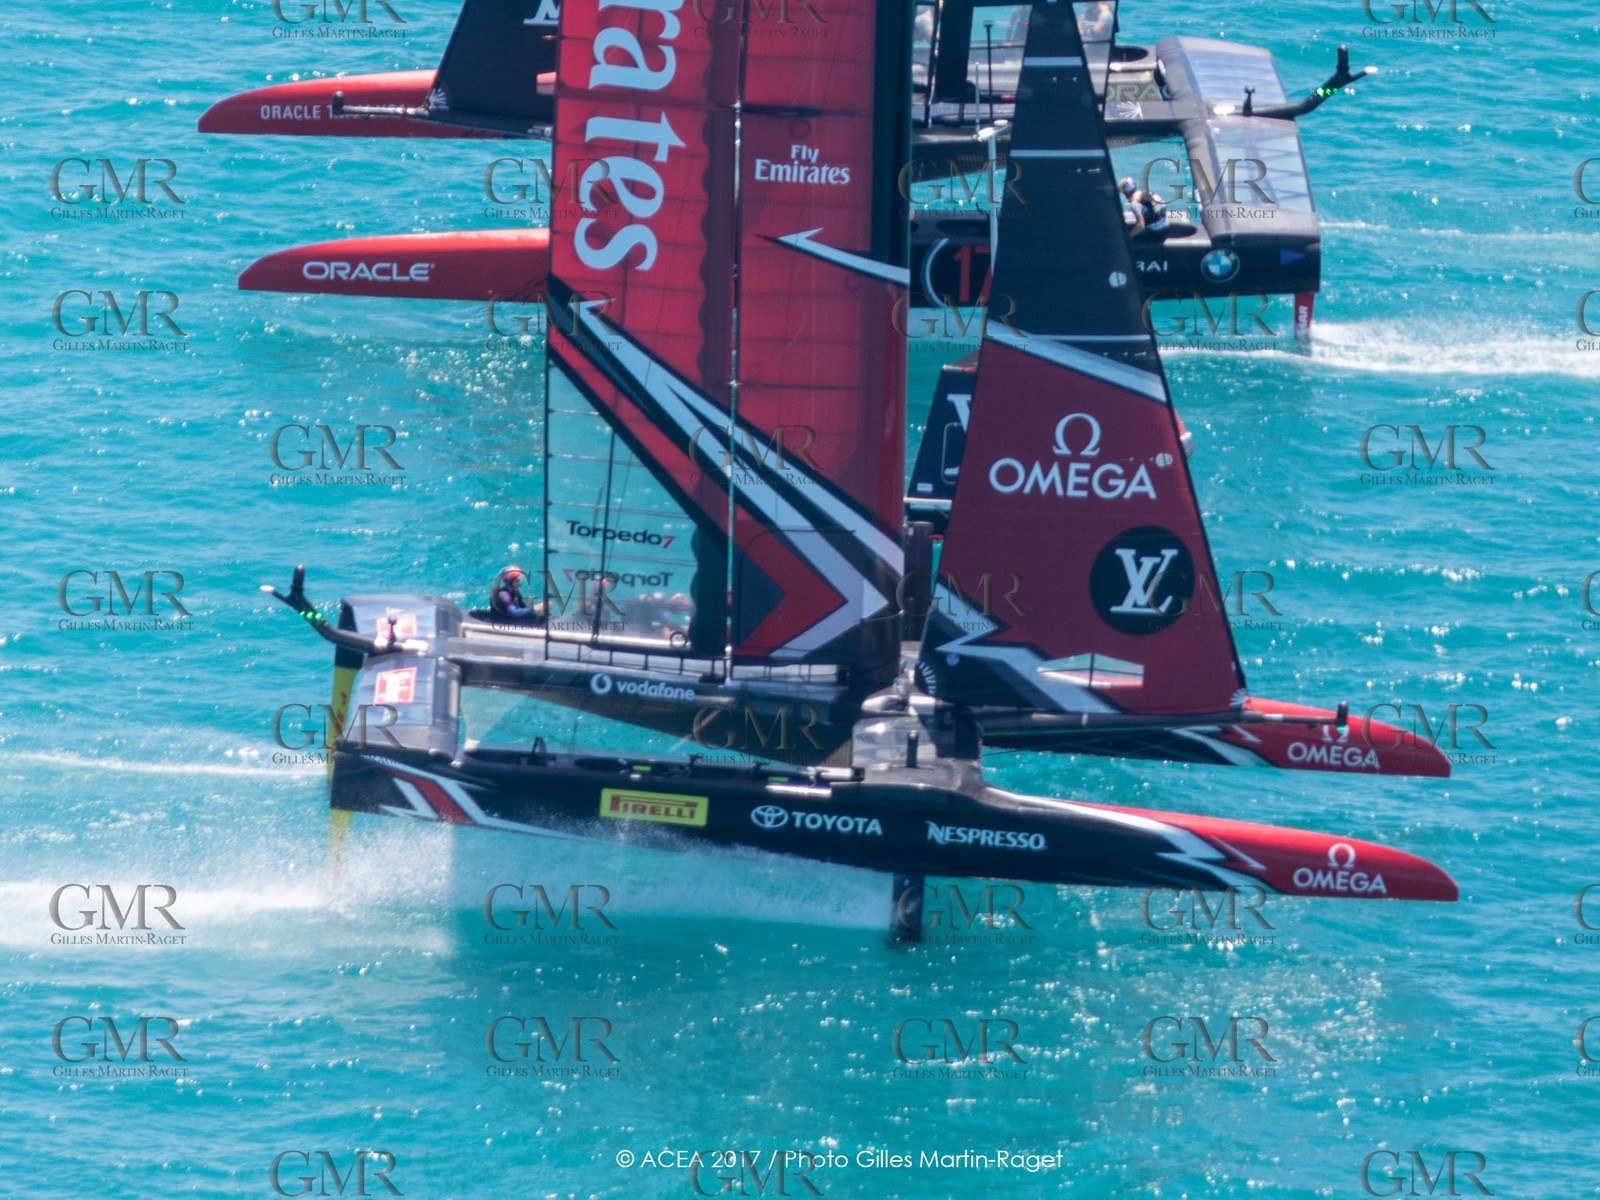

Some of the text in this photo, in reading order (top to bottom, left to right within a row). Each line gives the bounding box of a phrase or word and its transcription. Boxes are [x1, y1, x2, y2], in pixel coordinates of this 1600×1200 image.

[260, 105, 321, 120] ORACLE
[791, 144, 819, 163] Fly
[755, 159, 850, 185] Emirates
[302, 261, 430, 282] ORACLE
[988, 457, 1157, 499] OMEGA
[566, 520, 676, 549] Torpedo7
[1110, 548, 1178, 615] LV
[616, 681, 696, 700] vodafone
[1287, 742, 1380, 769] OMEGA
[610, 794, 698, 819] PIRELLI
[792, 811, 883, 836] TOYOTA
[925, 820, 1046, 850] NESPRESSO
[1293, 867, 1387, 894] OMEGA
